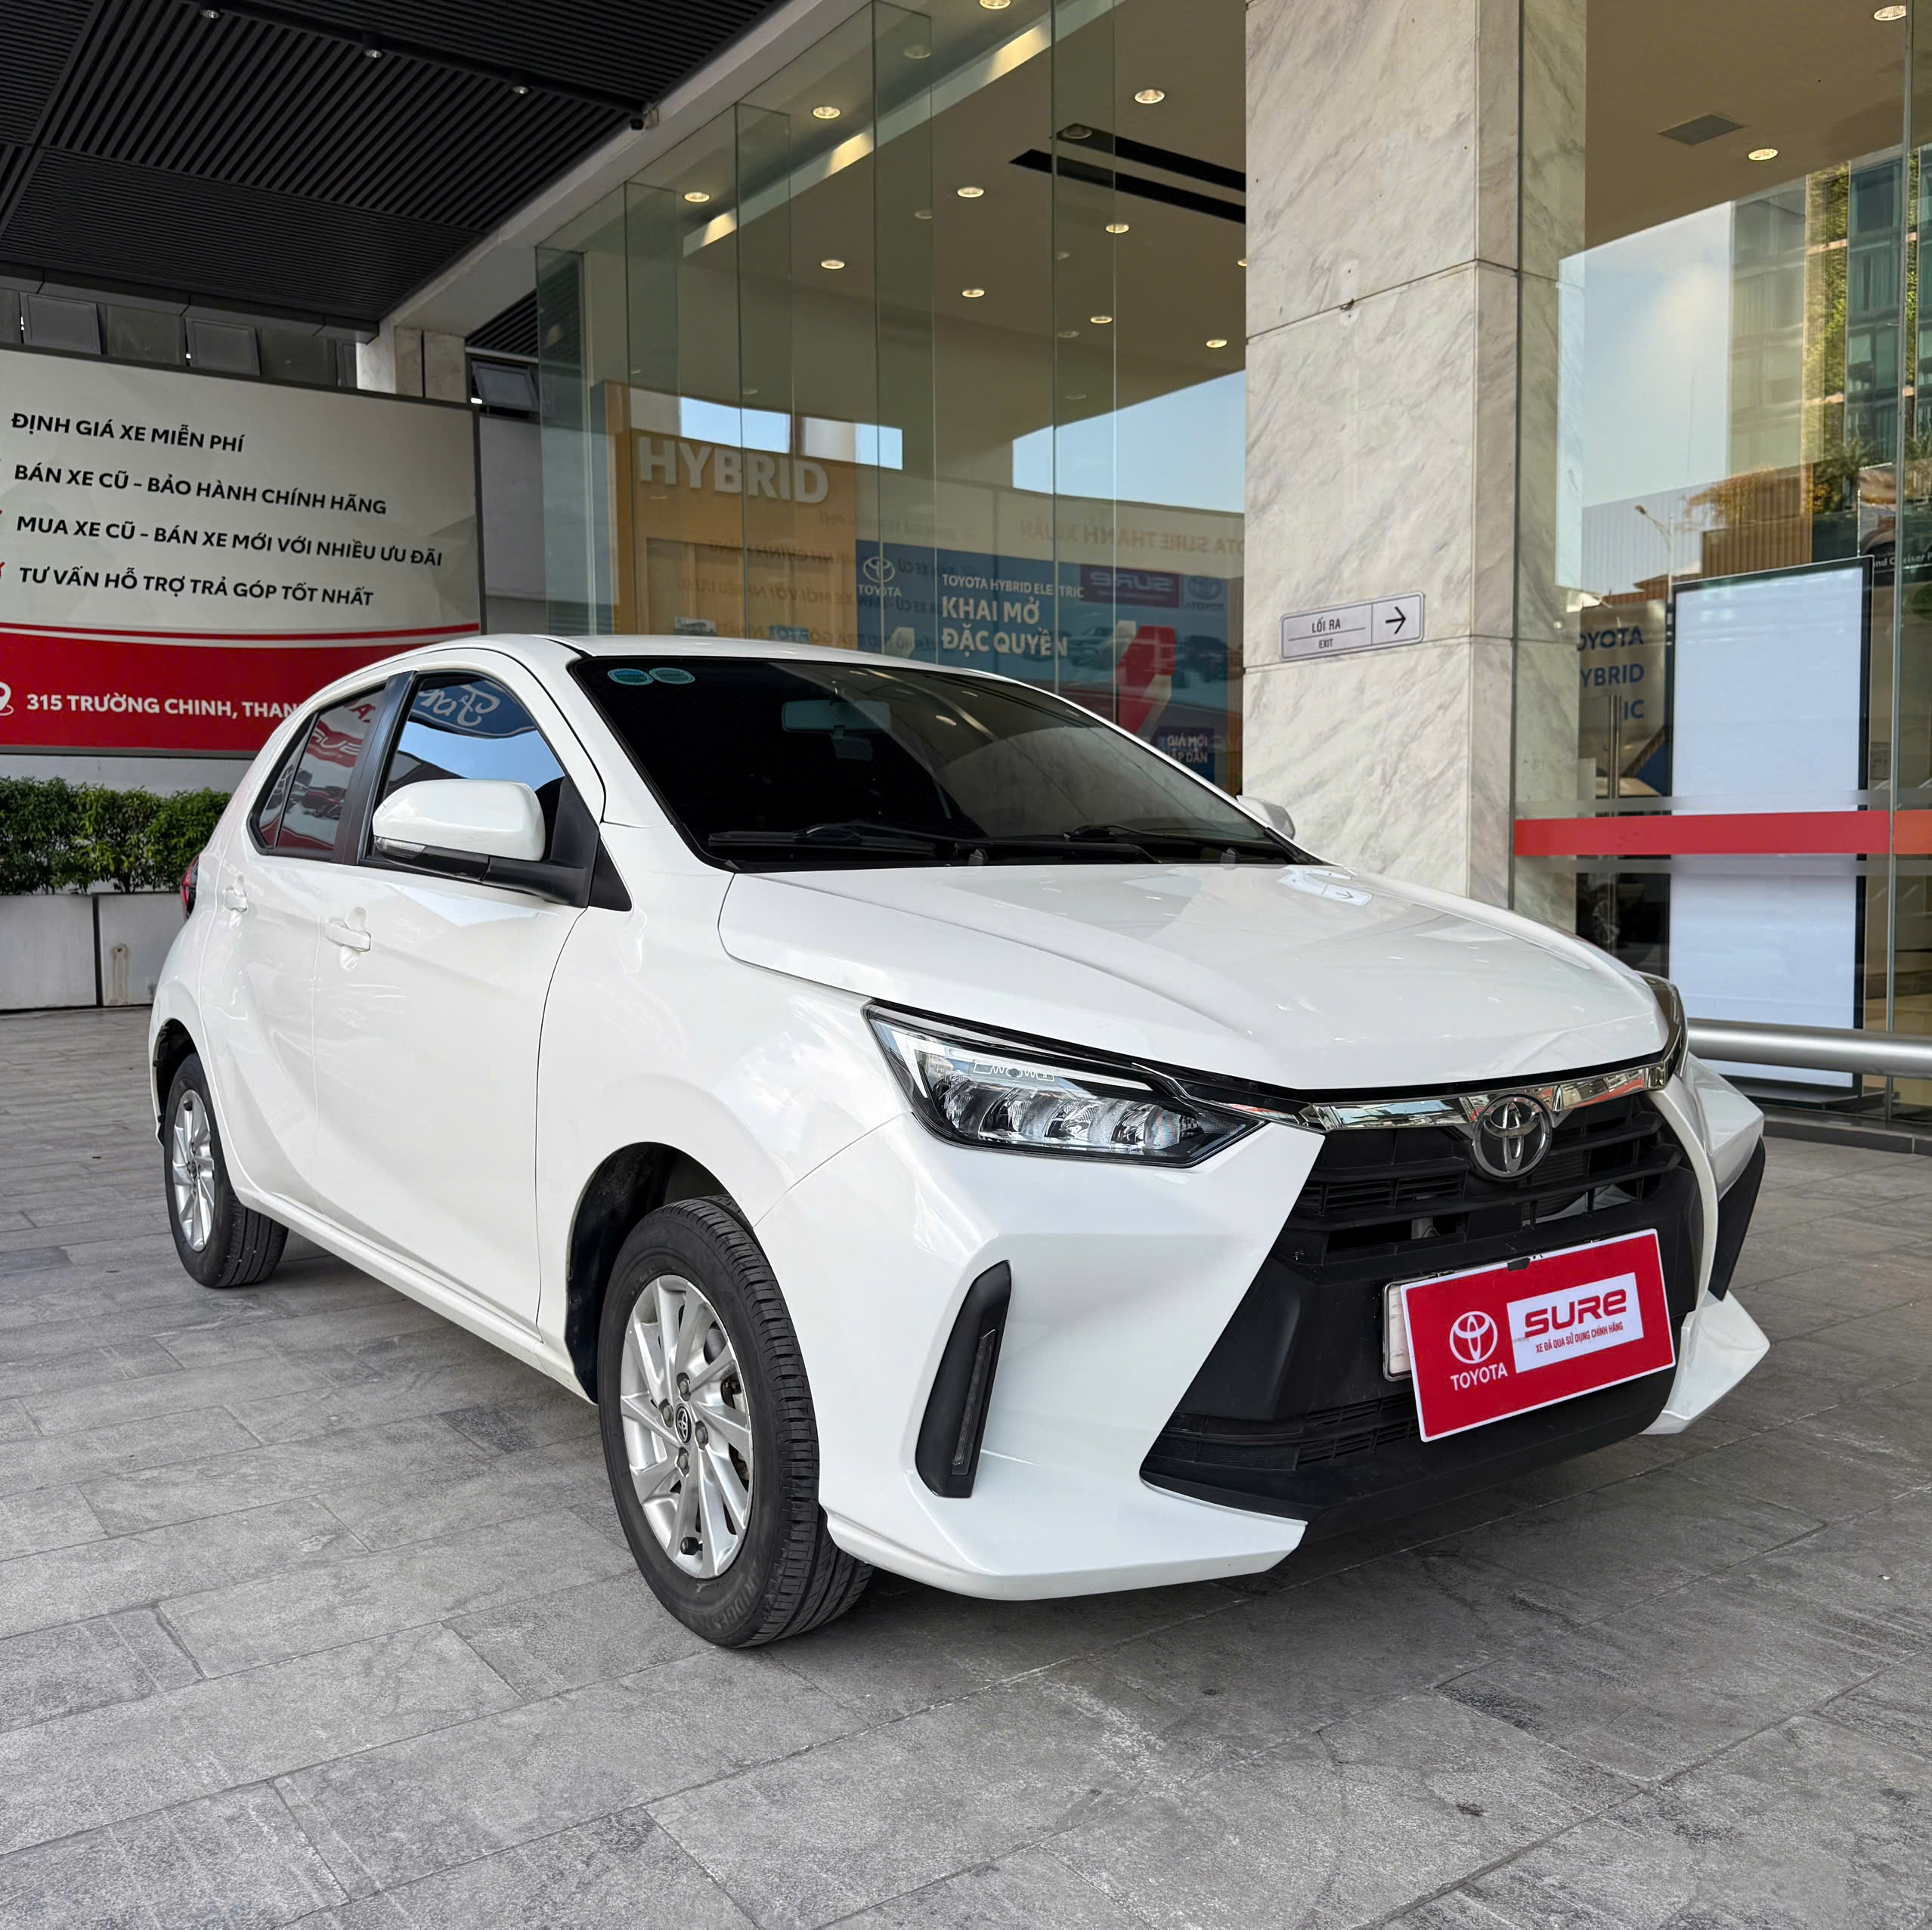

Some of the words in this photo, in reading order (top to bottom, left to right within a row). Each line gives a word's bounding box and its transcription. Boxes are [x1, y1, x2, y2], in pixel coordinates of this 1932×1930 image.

[11, 413, 70, 435] ĐỊNH
[76, 419, 114, 439] GIÁ
[120, 425, 146, 441] XE
[151, 424, 205, 448] MIỄN
[209, 434, 246, 452] PHÍ
[638, 436, 828, 503] HYBRID
[14, 462, 62, 484] BÁN
[67, 469, 94, 487] XE
[98, 470, 128, 489] CŨ
[147, 473, 192, 496] BẢO
[197, 480, 256, 502] HÀNH
[262, 487, 326, 508] CHÍNH
[330, 493, 387, 514] HÃNG
[17, 516, 68, 534] MUA
[73, 521, 101, 537] XE
[106, 521, 135, 540] CŨ
[154, 525, 198, 545] BÁN
[202, 531, 228, 547] XE
[232, 533, 272, 552] MỚI
[277, 536, 311, 555] VỚI
[317, 539, 376, 560] NHIỀU
[380, 545, 407, 562] ƯU
[410, 549, 442, 567] ĐÃI
[20, 566, 51, 584] TƯ
[53, 566, 99, 587] VẤN
[104, 568, 138, 589] HỖ
[143, 575, 185, 598] TRỢ
[190, 576, 228, 596] TRẢ
[233, 580, 277, 598] GÓP
[282, 582, 318, 603] TỐT
[322, 586, 374, 606] NHẤT
[943, 574, 988, 589] TOYOTA
[990, 578, 1032, 593] HYBRID
[1034, 583, 1084, 598] ELETRIC
[942, 595, 998, 621] KHAI
[1003, 596, 1040, 625] MỞ
[1329, 618, 1341, 631] RA
[942, 623, 990, 658] ĐẶC
[993, 627, 1068, 657] QUYỀN
[1318, 638, 1333, 649] EXIT
[1577, 626, 1644, 651] OYOTA
[1580, 663, 1644, 688] YBRID
[26, 694, 62, 711] 315
[67, 691, 159, 714] TRƯỜNG
[164, 697, 237, 719] CHINH,
[242, 701, 302, 719] THAN
[1536, 1343, 1543, 1354] XE
[1544, 1338, 1553, 1351] ĐÃ
[1553, 1336, 1565, 1349] QUA
[1566, 1332, 1574, 1346] SỬ
[1574, 1331, 1590, 1347] DỤNG
[1591, 1325, 1608, 1340] CHÍNH
[1608, 1321, 1624, 1336] HÃNG
[1451, 1362, 1508, 1391] TOYOTA
